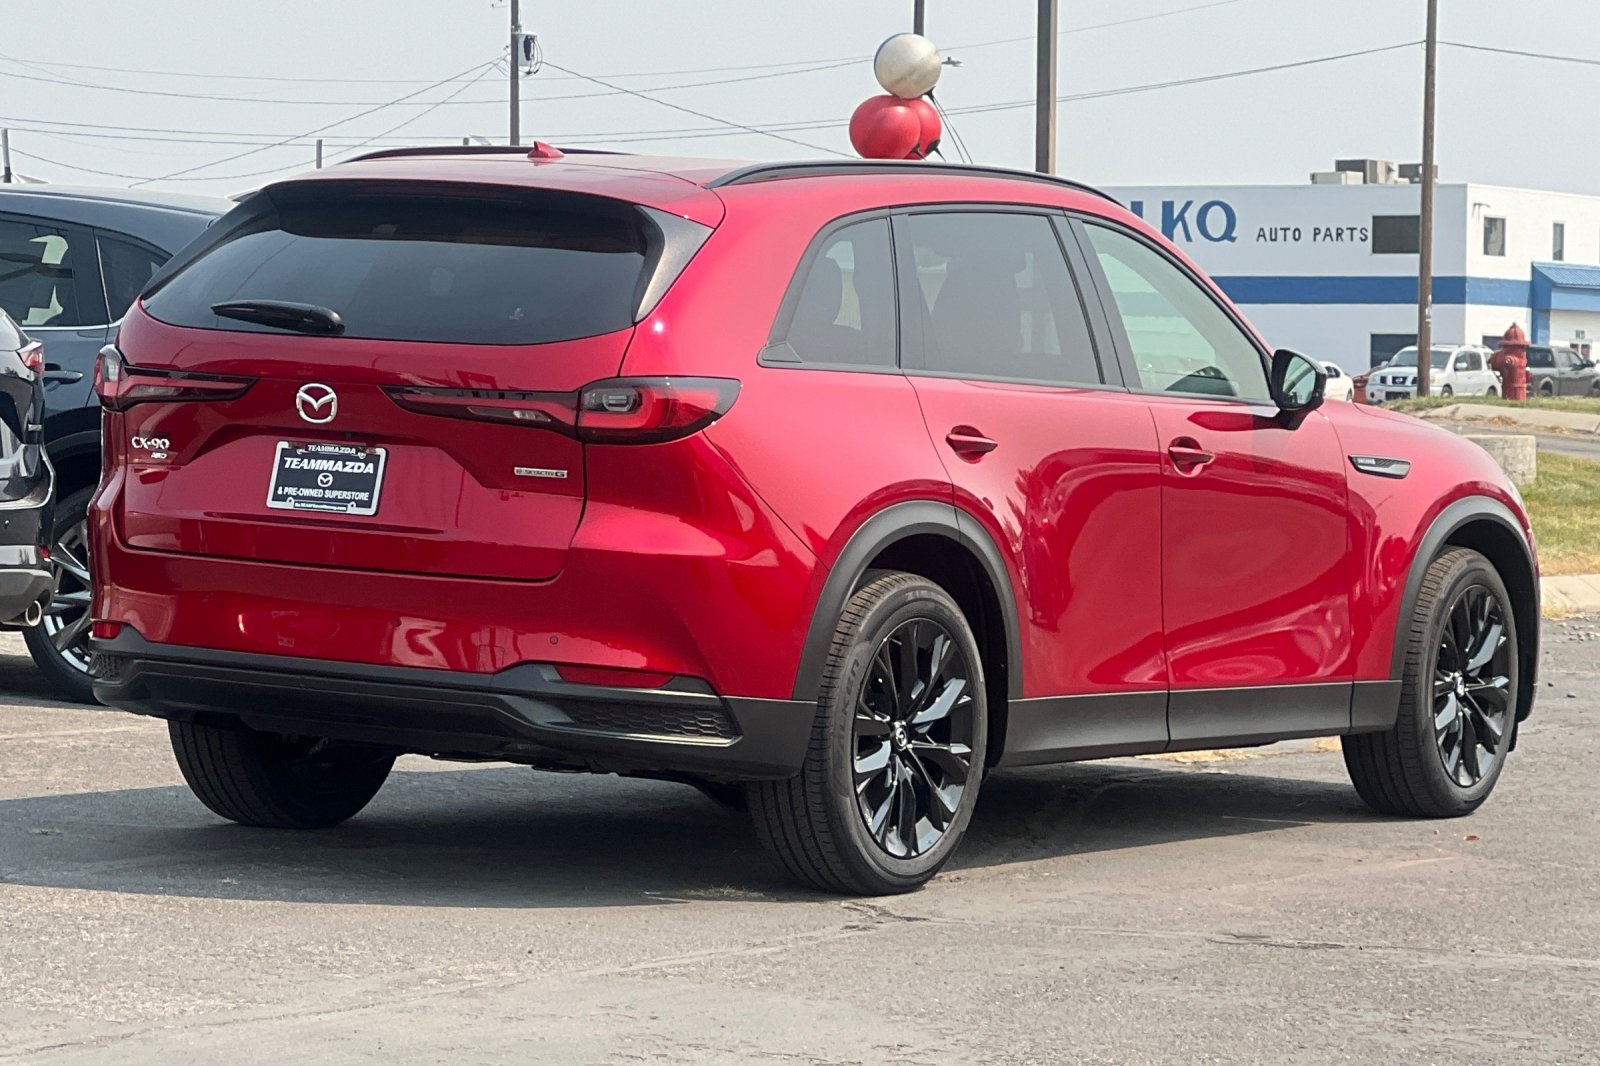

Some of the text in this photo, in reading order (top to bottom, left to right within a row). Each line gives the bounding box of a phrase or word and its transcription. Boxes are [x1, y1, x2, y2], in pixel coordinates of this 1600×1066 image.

[1256, 227, 1302, 243] AUTO
[1313, 227, 1369, 243] PARTS
[131, 436, 170, 450] CX-90
[277, 486, 370, 501] & PRE-OWNED SUPERSTORE
